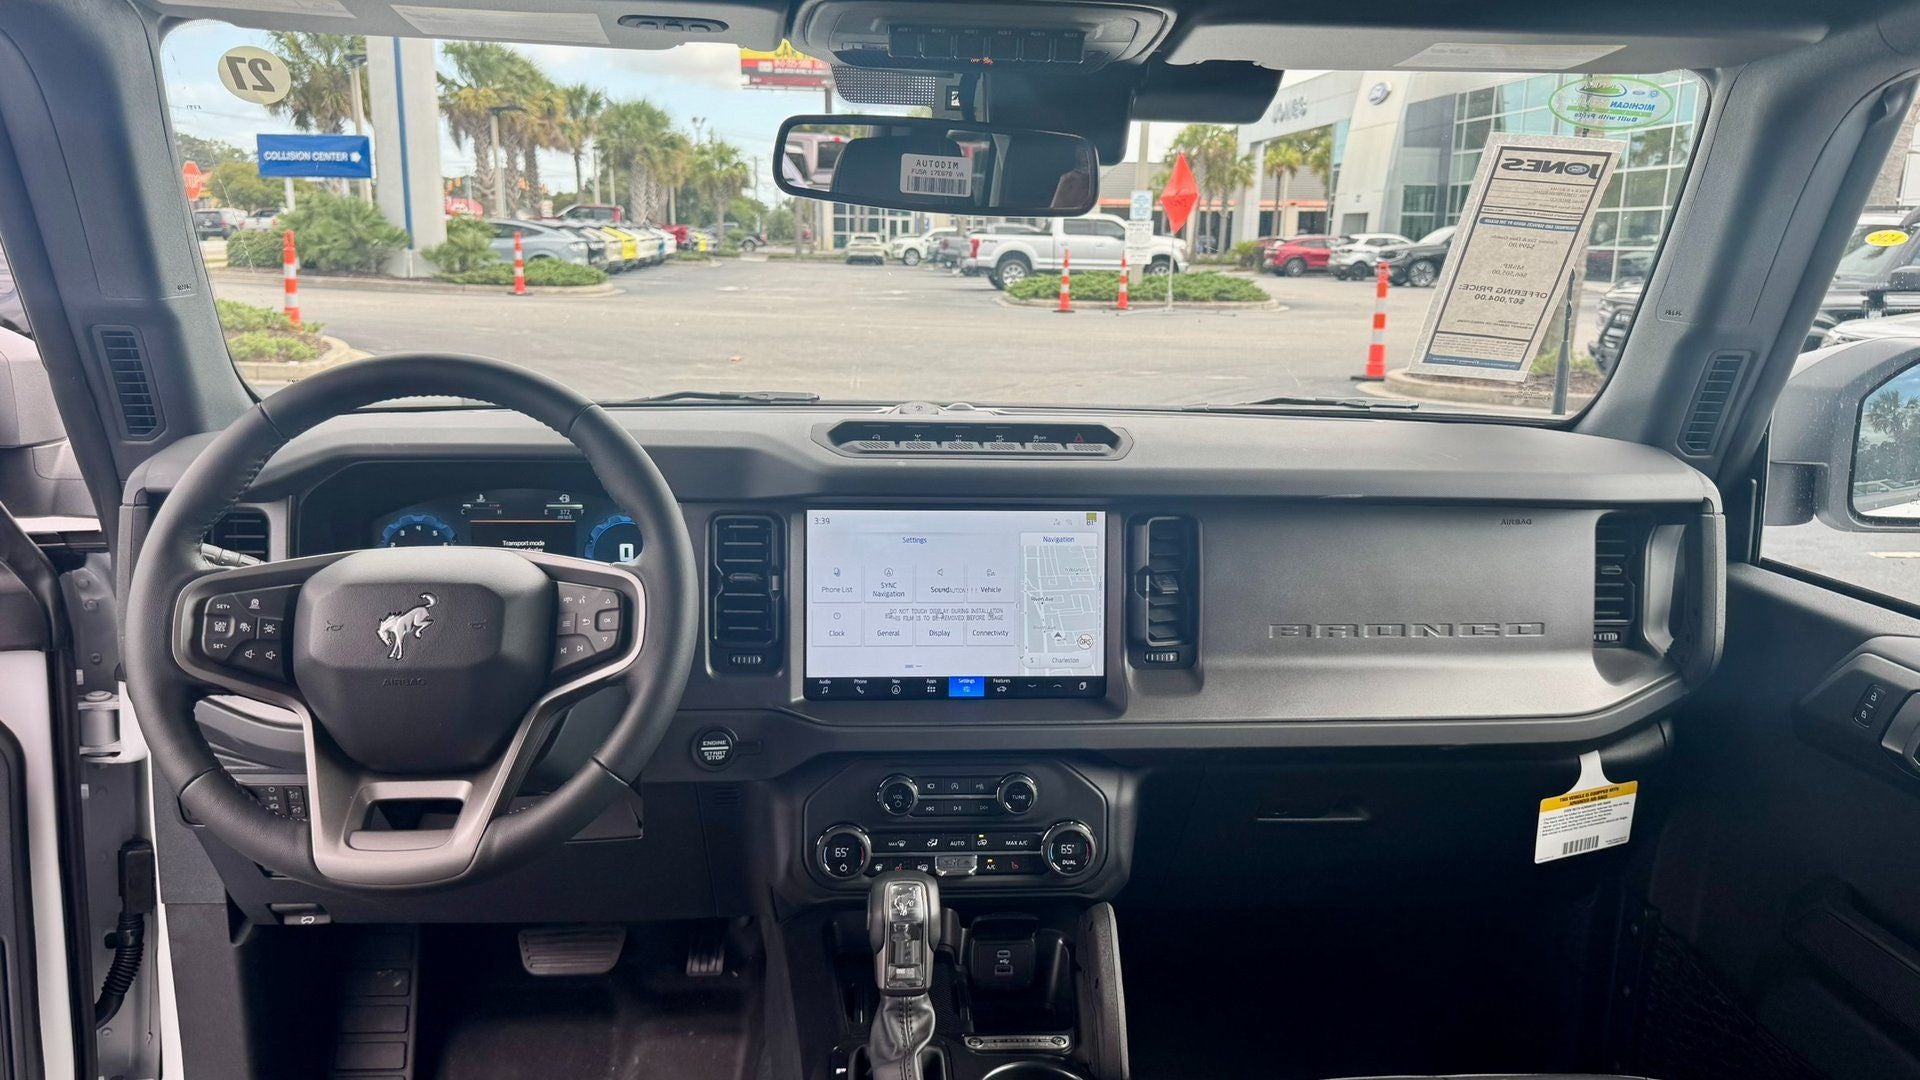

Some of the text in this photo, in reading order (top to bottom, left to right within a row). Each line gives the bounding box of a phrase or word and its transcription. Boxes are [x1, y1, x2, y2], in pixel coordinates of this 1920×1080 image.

[263, 150, 349, 162] COLLISION CENTER
[915, 159, 959, 169] AUTODIM
[814, 517, 830, 525] 3:39
[902, 536, 928, 544] Settings
[619, 543, 634, 562] 0
[880, 581, 897, 589] SYNC
[872, 590, 905, 598] Navigation
[929, 630, 951, 638] Display
[972, 629, 1009, 638] Connectivity
[1268, 622, 1545, 639] BRONCO
[1589, 789, 1608, 797] EQUIPPED
[1569, 798, 1590, 806] ADVANCED
[834, 847, 850, 858] 65°
[1060, 844, 1075, 855] 65°
